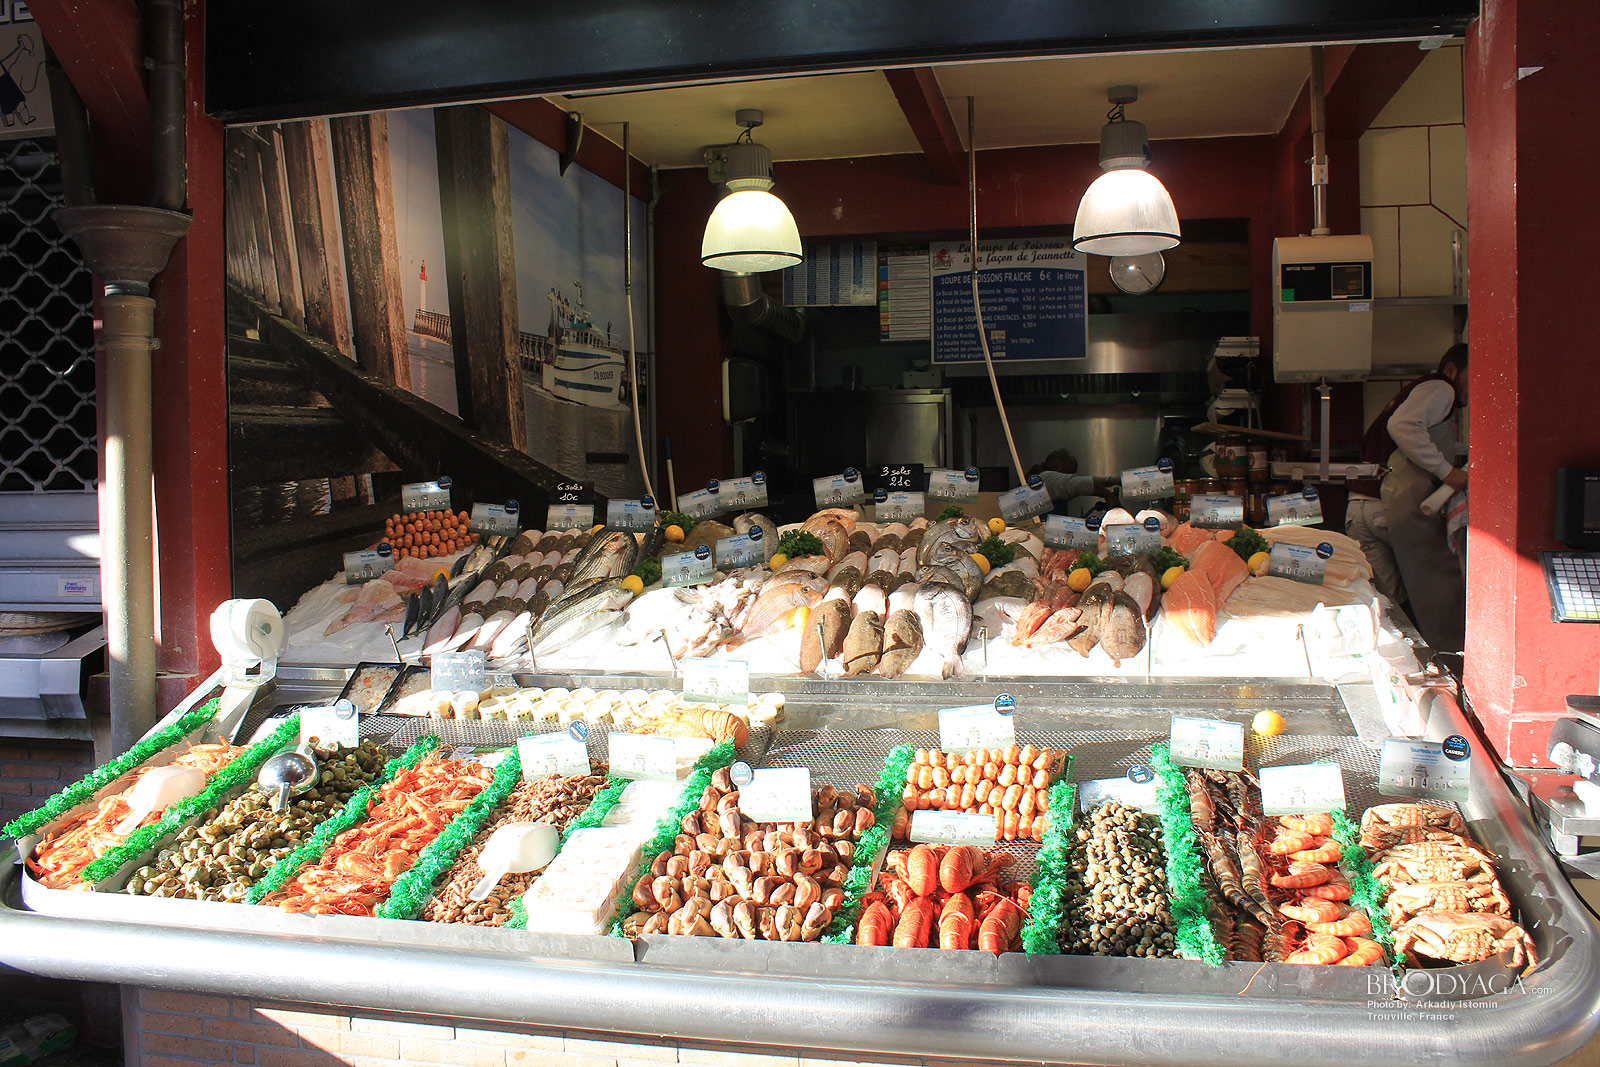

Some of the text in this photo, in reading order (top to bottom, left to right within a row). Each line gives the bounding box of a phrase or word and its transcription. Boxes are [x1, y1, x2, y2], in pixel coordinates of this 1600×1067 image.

[1008, 242, 1018, 251] de
[1022, 240, 1064, 250] Poissons
[986, 252, 1013, 264] façon
[1017, 252, 1029, 261] de
[1031, 250, 1077, 263] Jeannette
[941, 275, 961, 285] SOUPE
[963, 275, 971, 284] DE
[975, 272, 1003, 283] OISSONS
[1004, 271, 1032, 282] FRAICHE
[1065, 271, 1080, 280] litre
[881, 466, 911, 477] 3 soles
[557, 482, 564, 491] 6
